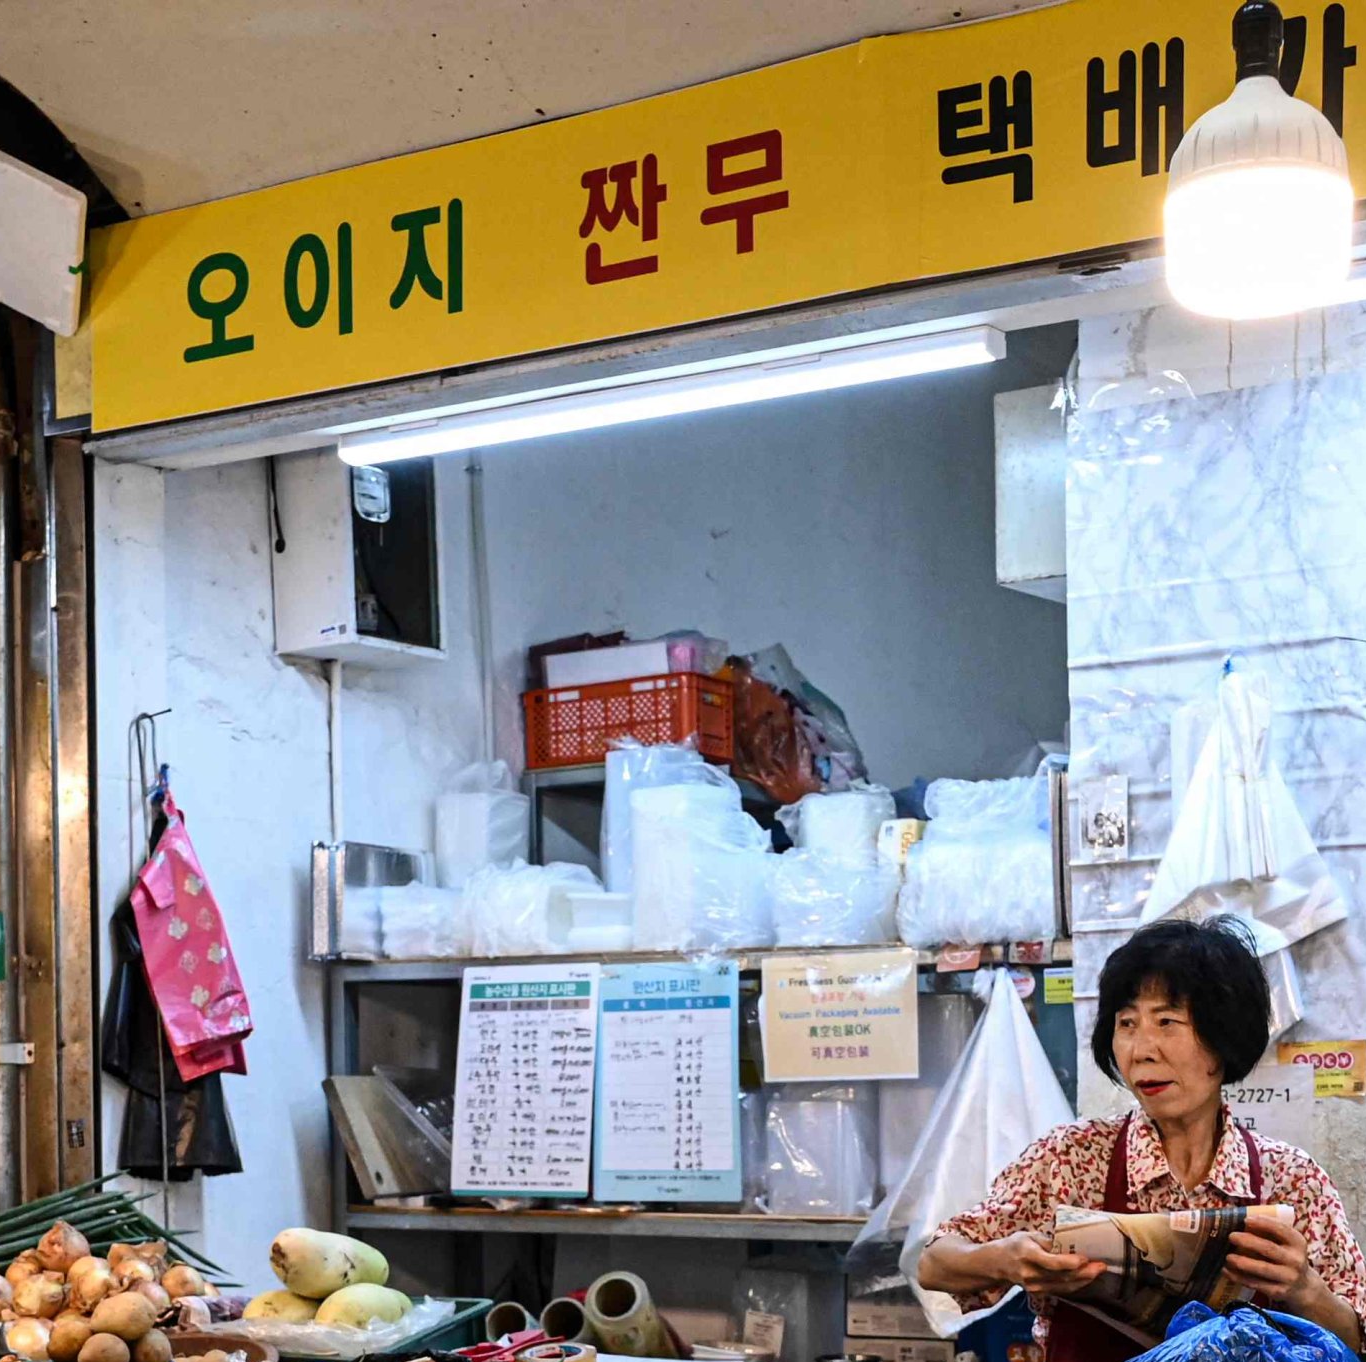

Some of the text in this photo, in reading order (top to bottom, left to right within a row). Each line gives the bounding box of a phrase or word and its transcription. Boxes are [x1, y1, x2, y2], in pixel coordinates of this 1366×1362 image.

[183, 129, 790, 364] 오이지 짠무
[632, 979, 666, 994] 원산지
[778, 1007, 901, 1020] Vacuum Packaging Available
